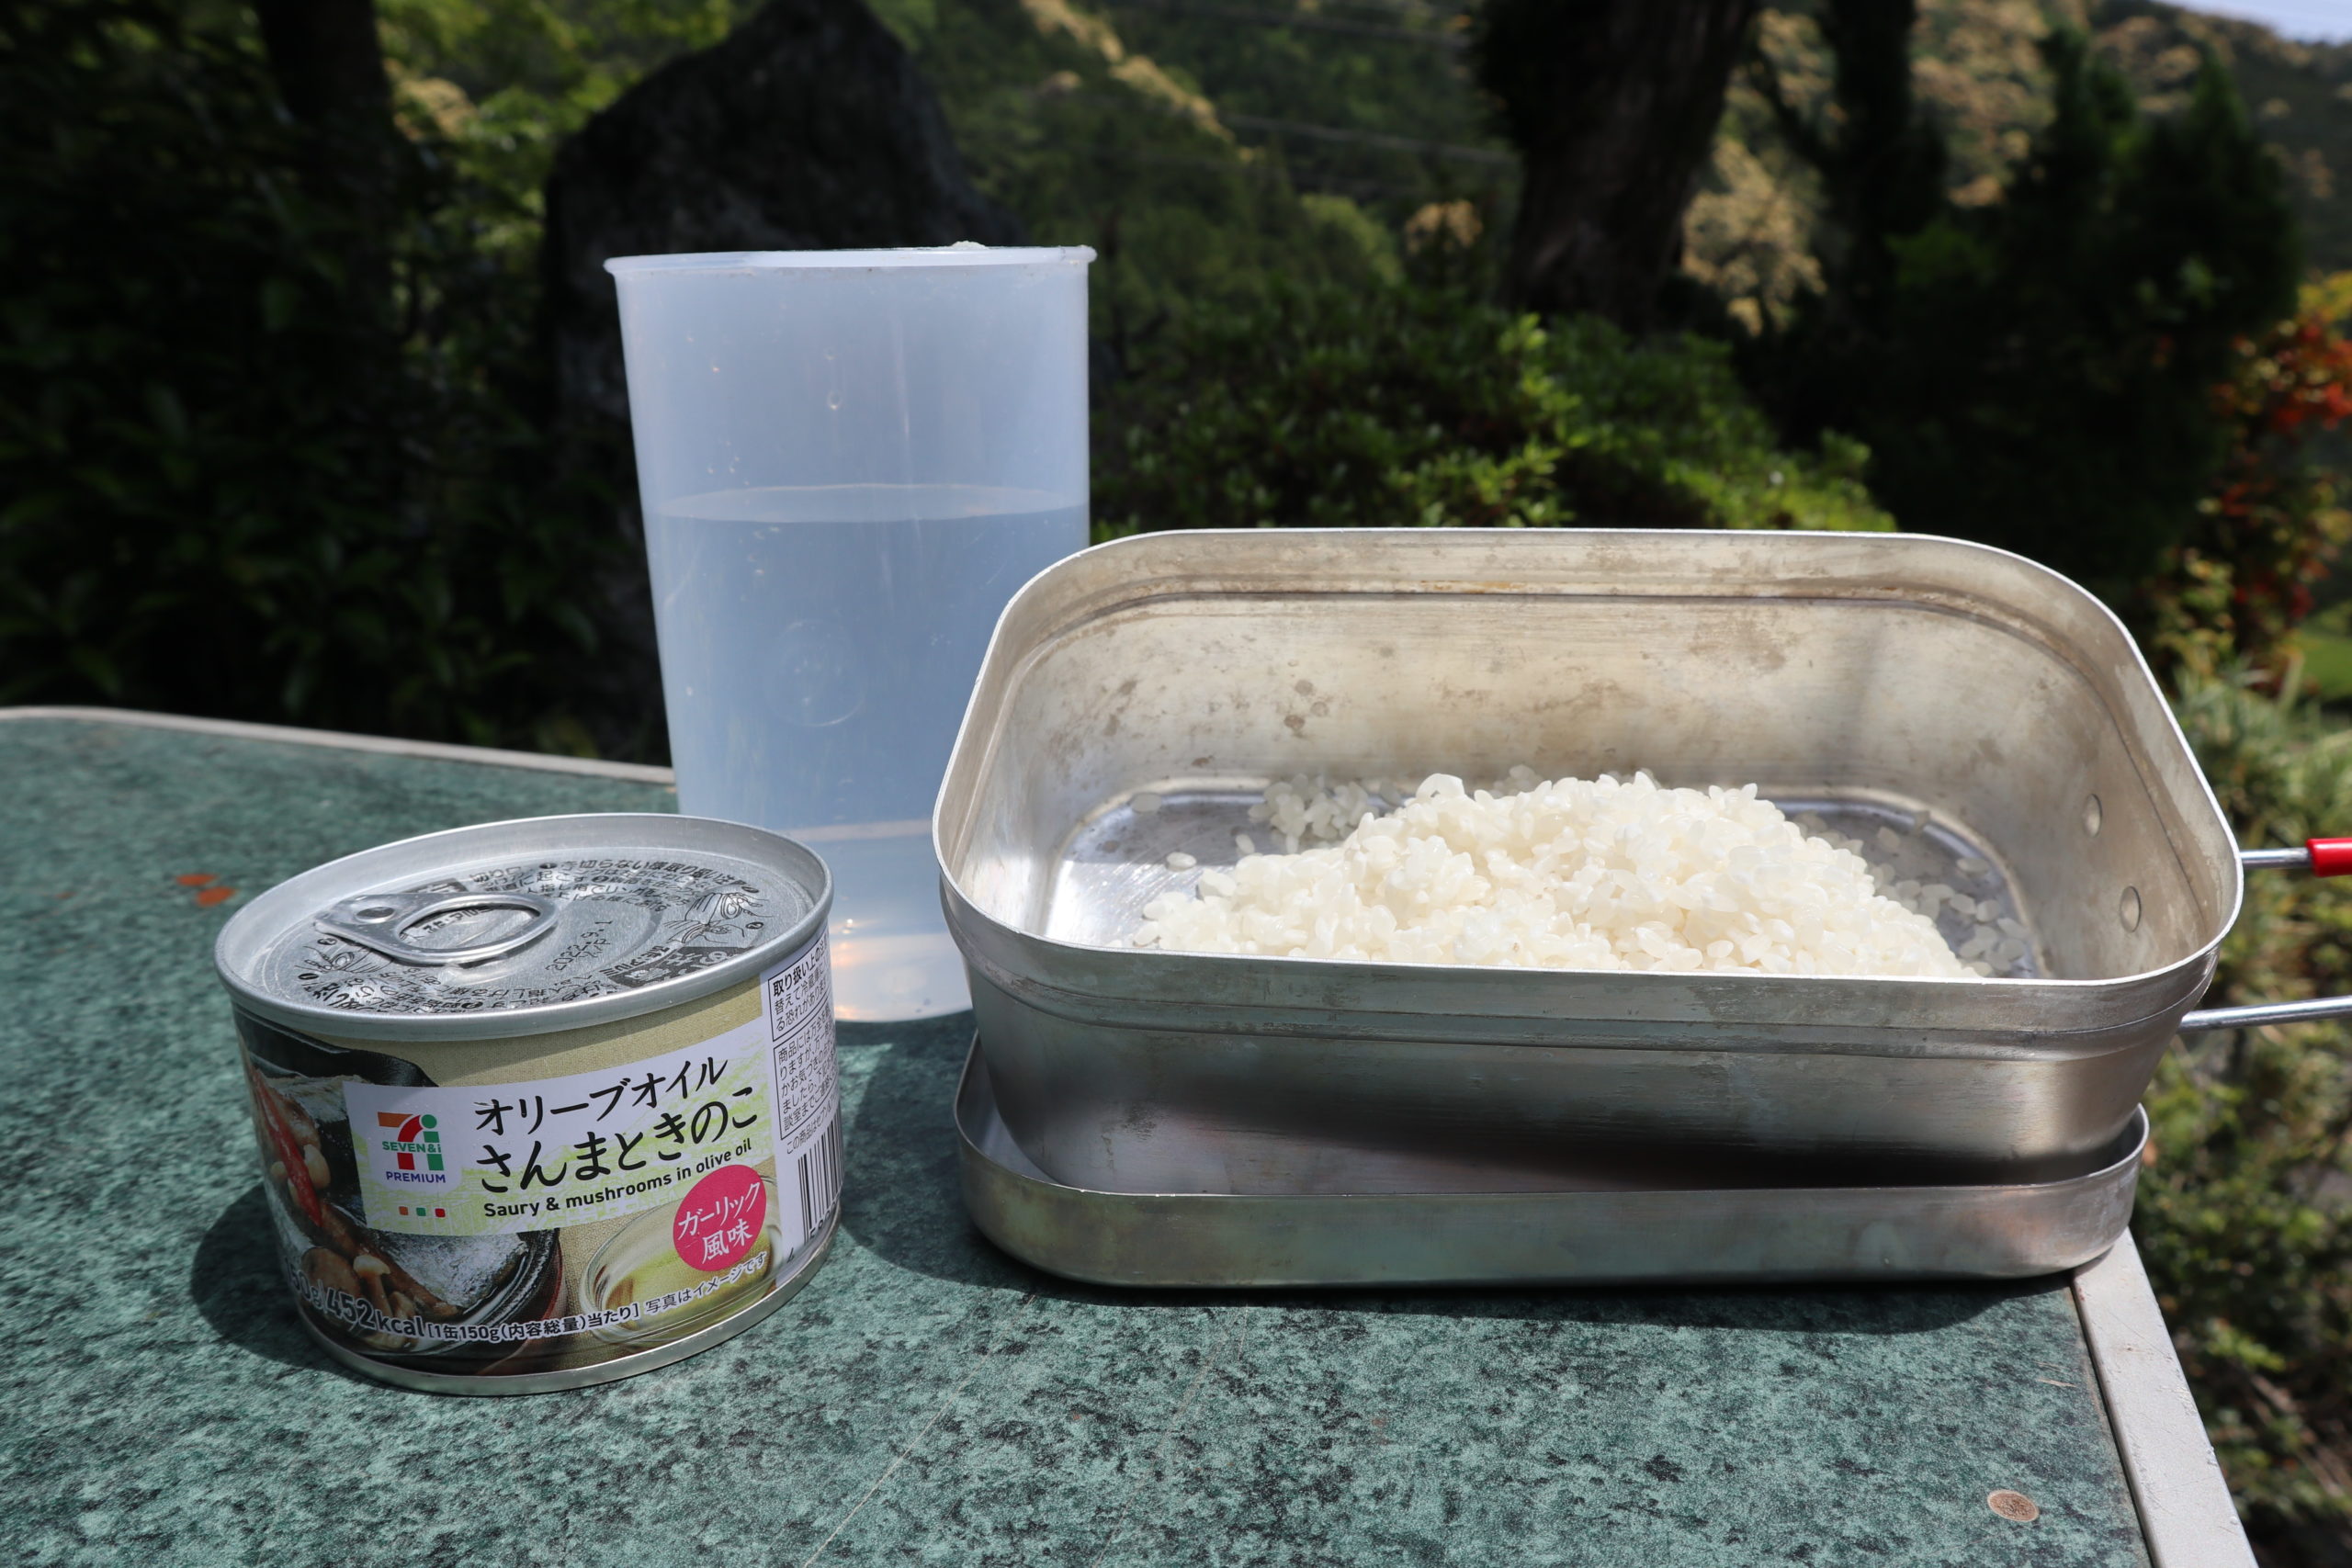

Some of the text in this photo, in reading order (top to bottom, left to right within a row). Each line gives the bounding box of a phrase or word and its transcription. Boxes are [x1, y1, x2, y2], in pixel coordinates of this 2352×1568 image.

[474, 1056, 729, 1135] オリーブオイル
[476, 1087, 758, 1193] さんまときのこ
[385, 1171, 447, 1183] PREMIUM
[484, 1138, 752, 1217] Saury & mushrooms in olive oil
[677, 1181, 761, 1241] ガーリック
[701, 1221, 754, 1265] 風味
[645, 1251, 767, 1314] 写真はイメージです
